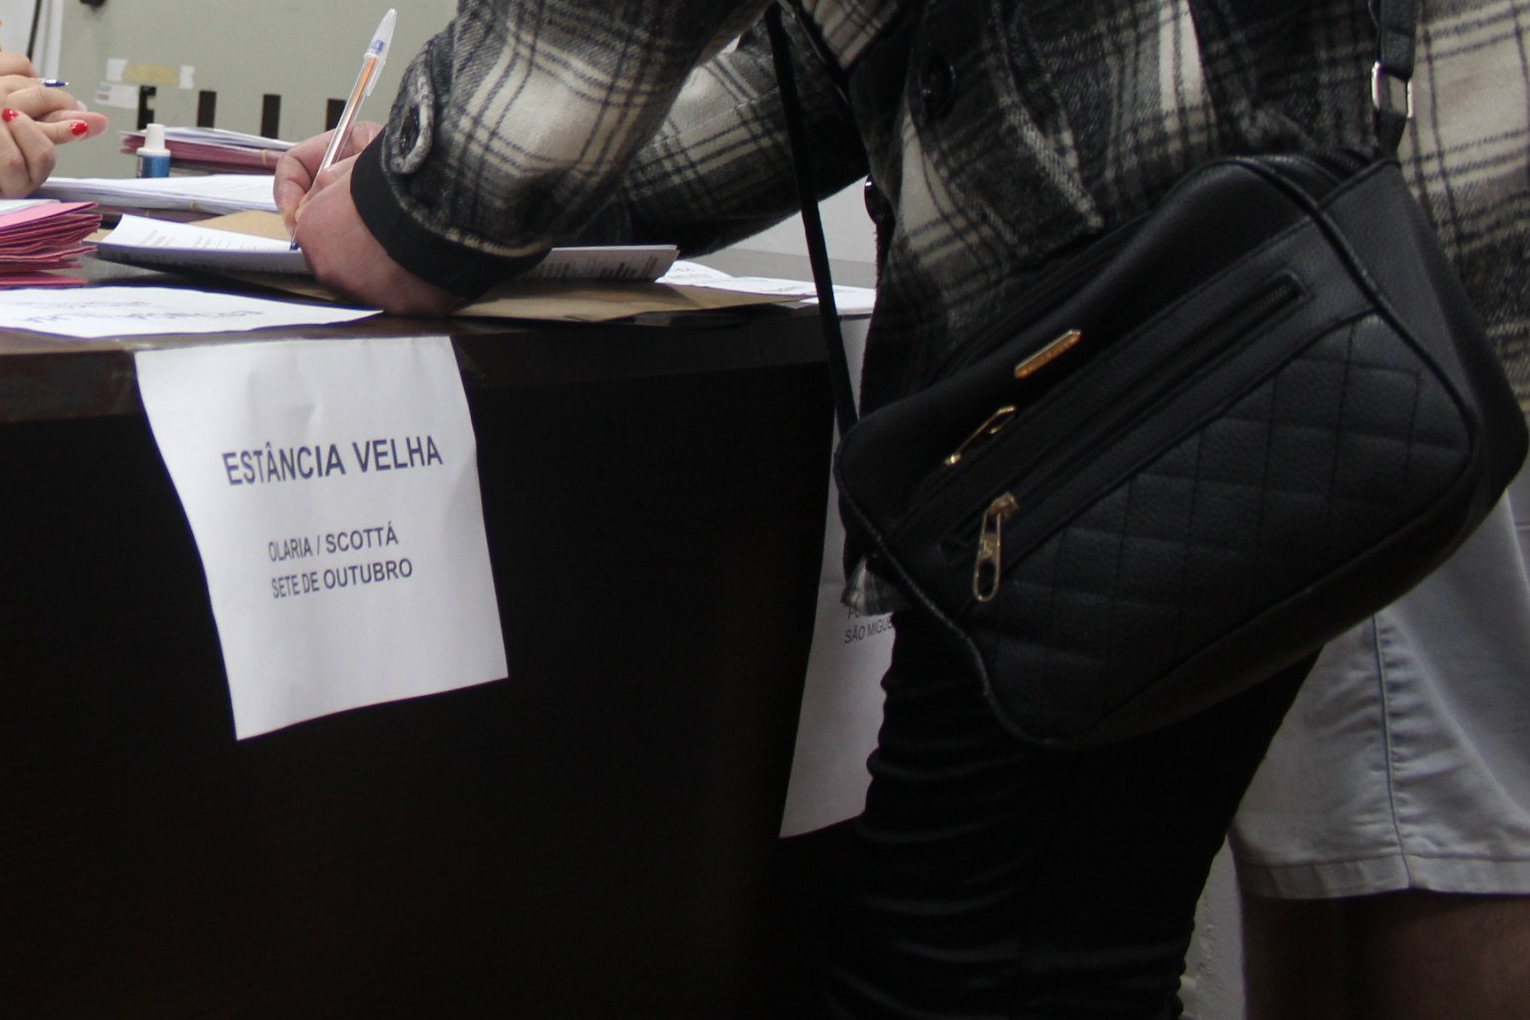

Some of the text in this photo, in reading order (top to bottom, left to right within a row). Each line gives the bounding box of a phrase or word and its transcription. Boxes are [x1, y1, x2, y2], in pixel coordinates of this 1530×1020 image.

[222, 435, 443, 486] ESTÂNCIA VELHA
[268, 536, 313, 562] OLARIA
[325, 521, 398, 554] SCOTTÁ
[271, 558, 413, 599] SETE DE OUTUBRO
[844, 617, 893, 644] SÃO MIGUE
